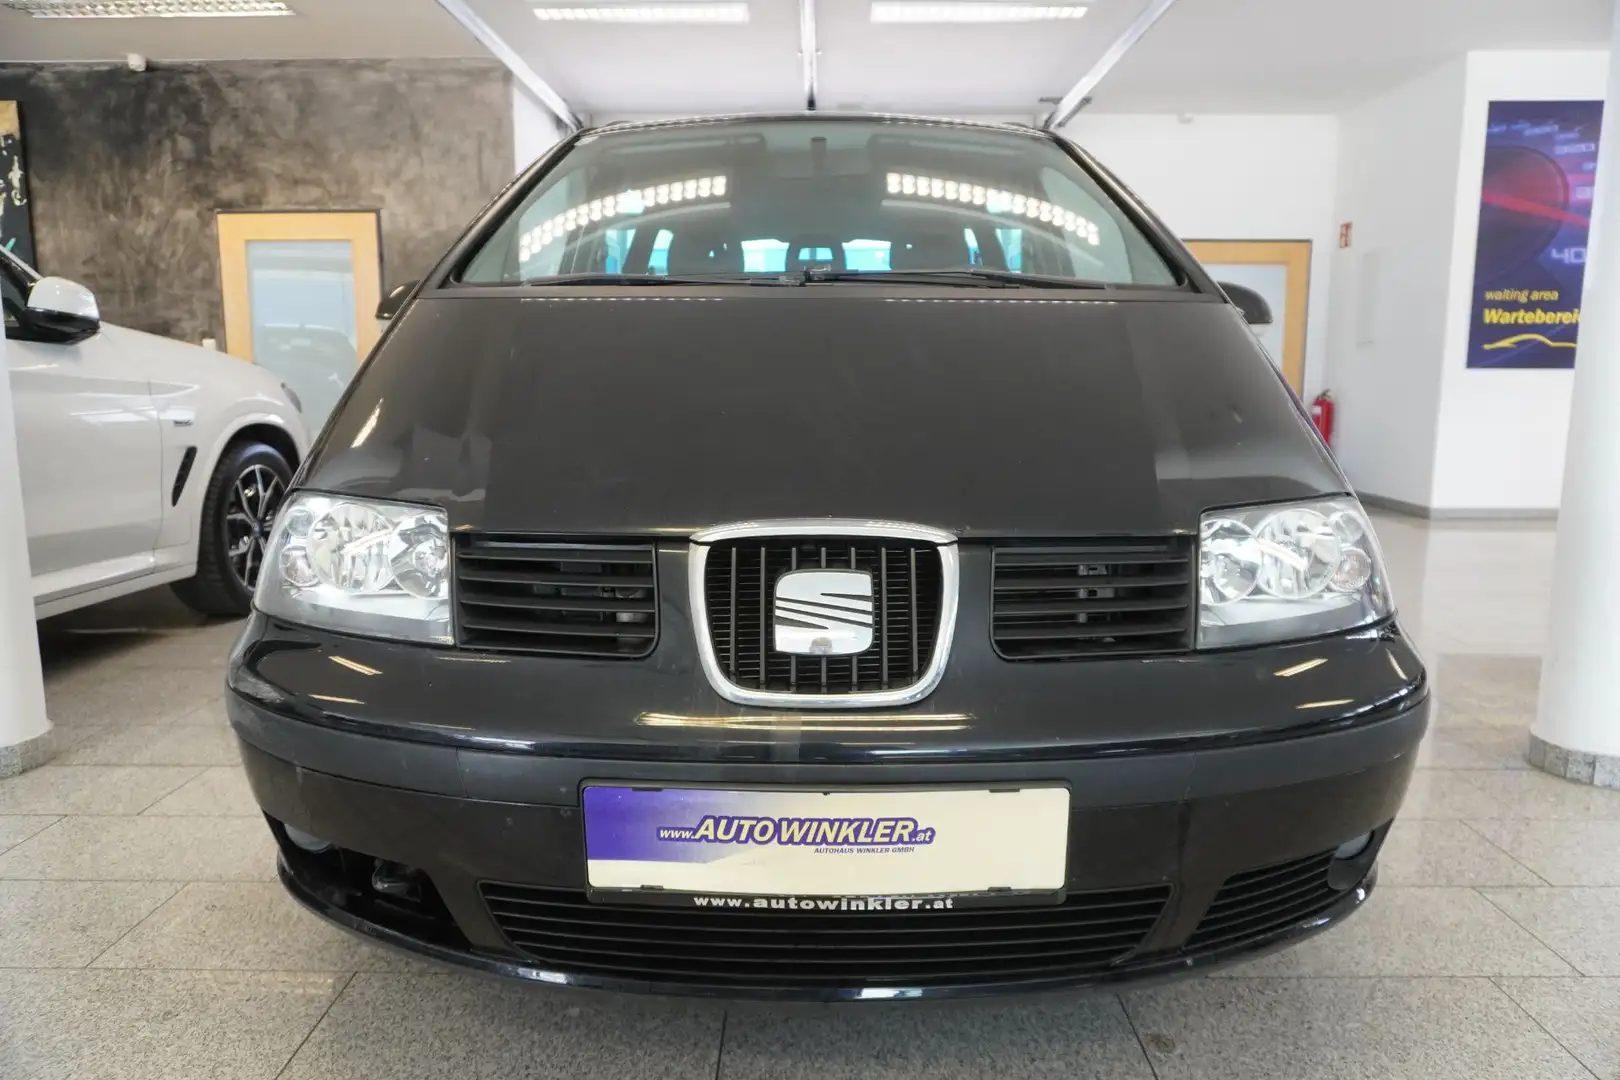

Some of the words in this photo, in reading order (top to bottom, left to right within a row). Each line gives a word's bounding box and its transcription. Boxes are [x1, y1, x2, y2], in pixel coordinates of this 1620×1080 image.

[1484, 288, 1529, 303] waiting
[1530, 290, 1559, 301] area
[1483, 308, 1580, 324] Warteberei
[693, 896, 954, 911] www.autowinkler.at
